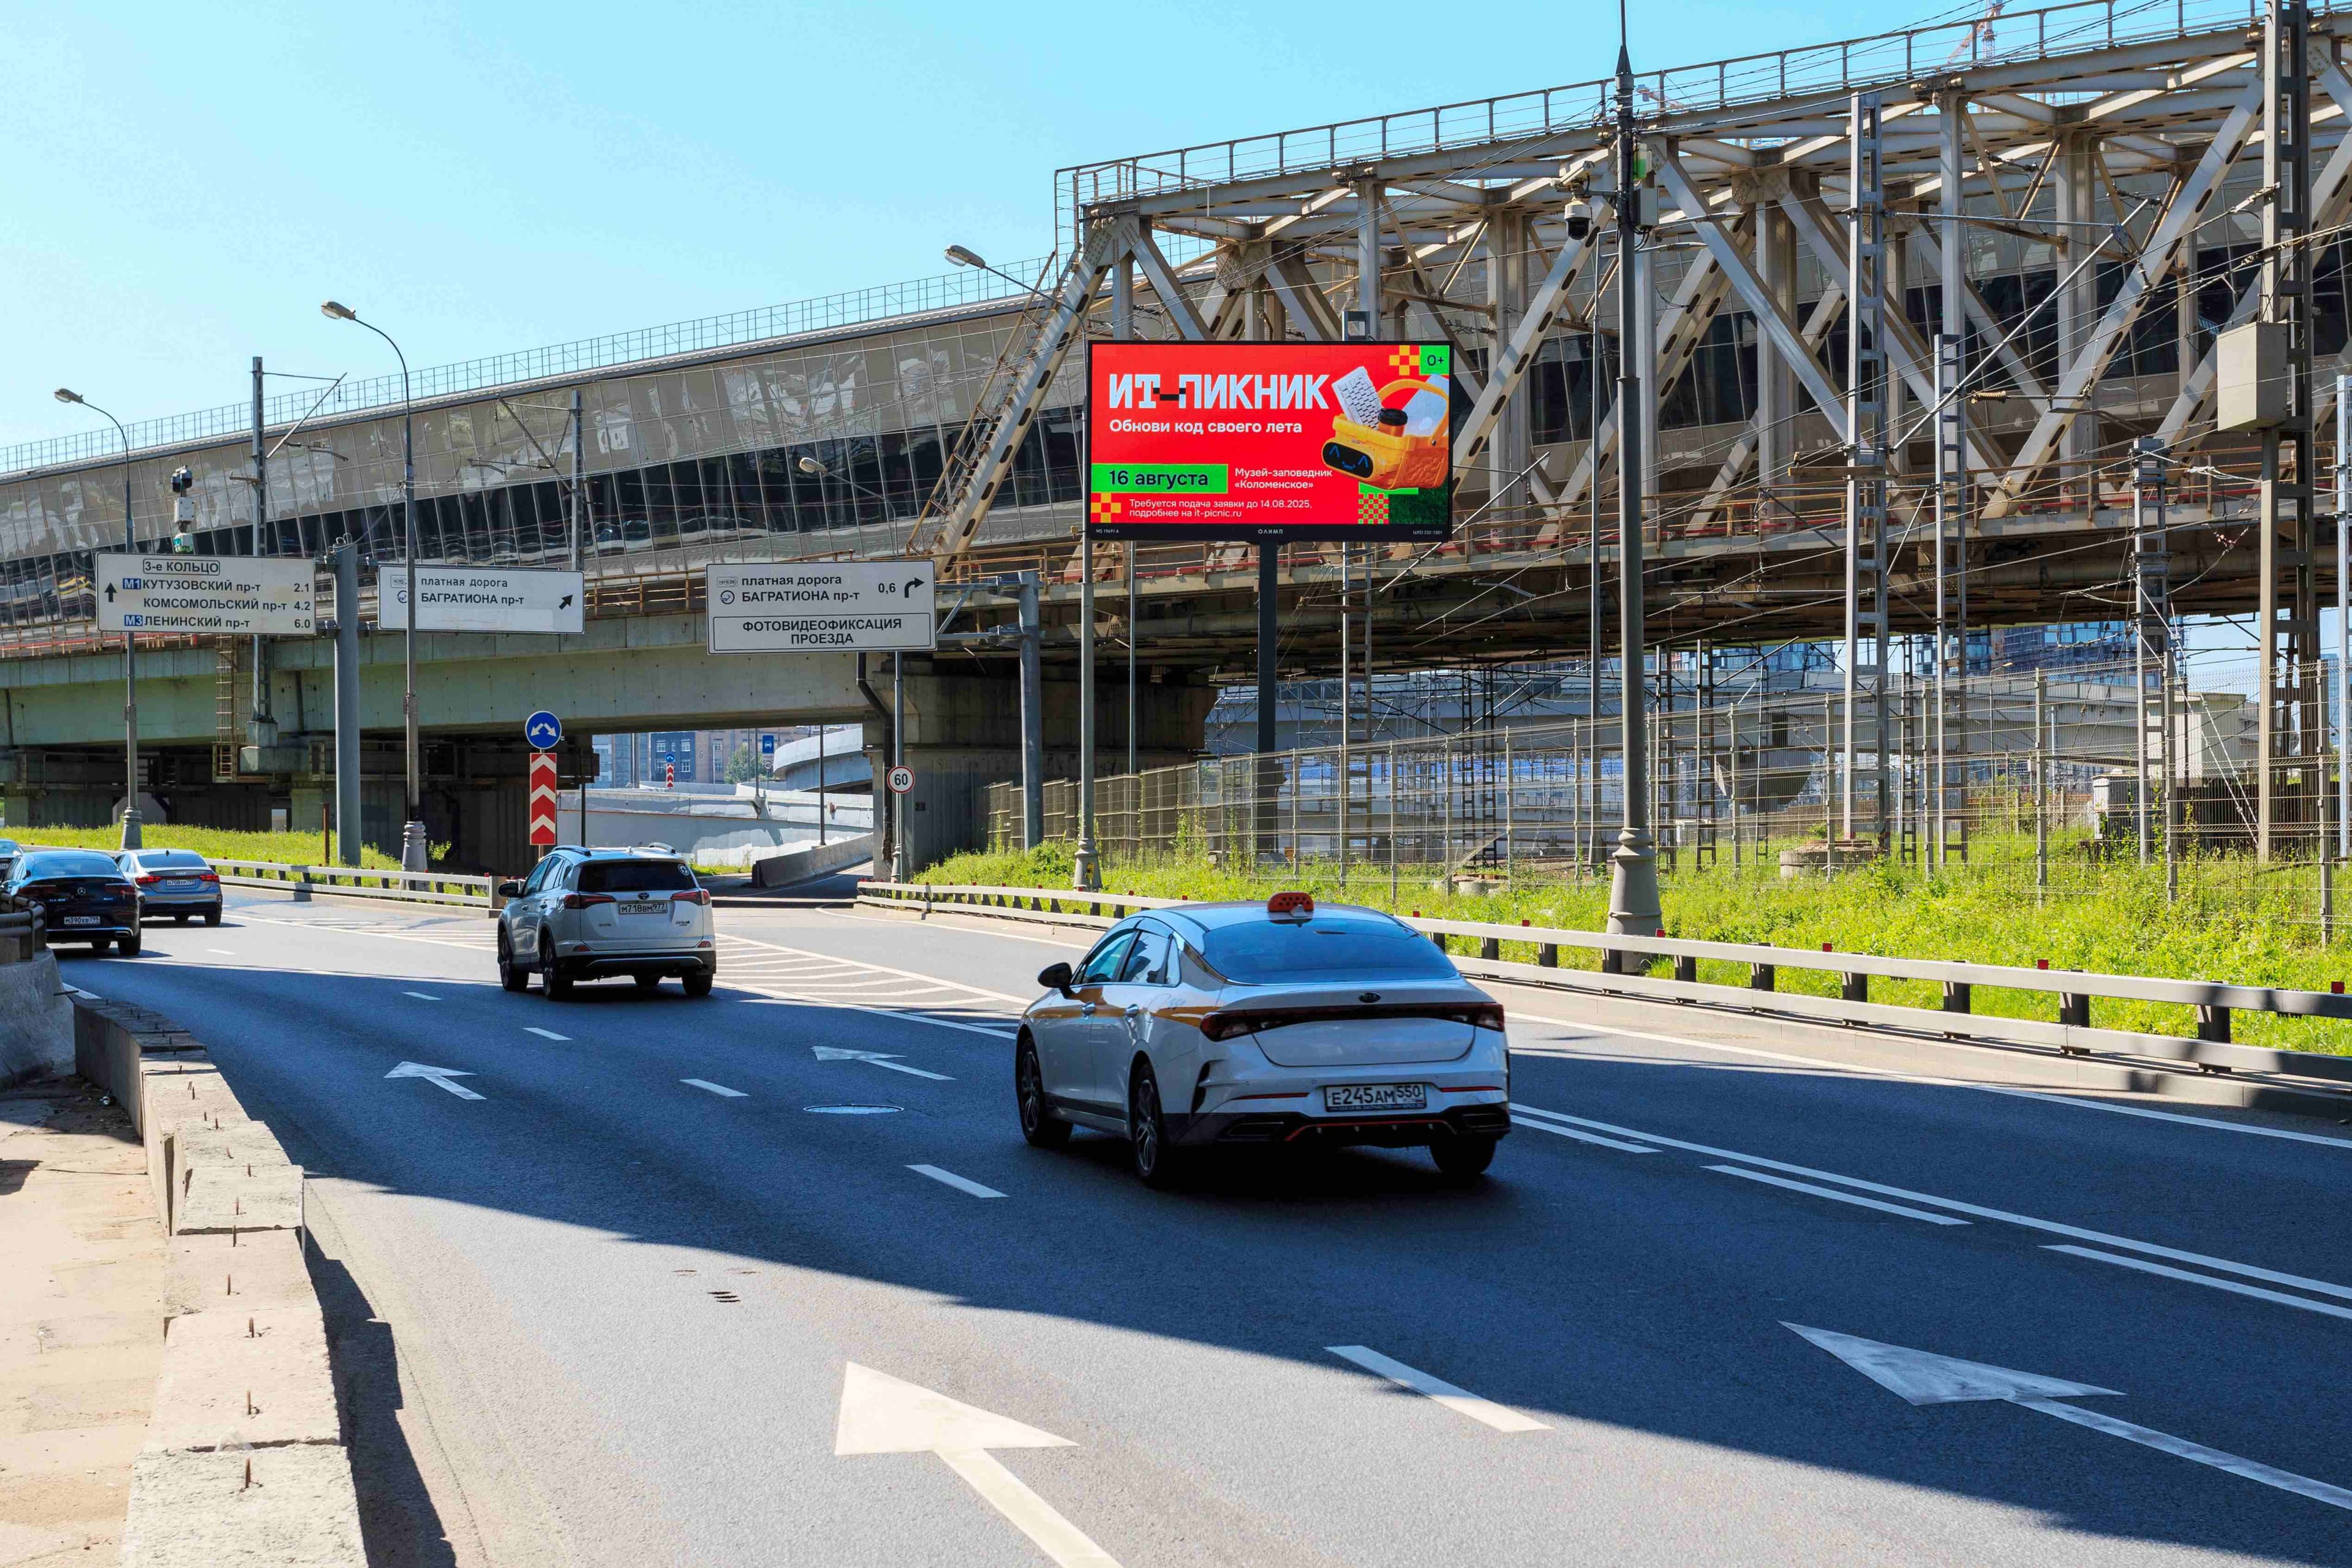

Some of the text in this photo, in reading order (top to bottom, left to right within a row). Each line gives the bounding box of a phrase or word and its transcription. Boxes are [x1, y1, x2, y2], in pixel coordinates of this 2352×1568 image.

[1427, 355, 1444, 366] 0+
[1109, 374, 1330, 409] ИТ-ПИКНИК
[1110, 419, 1302, 434] Обнови код своего лета
[1109, 470, 1208, 489] 16 августа
[1235, 468, 1332, 479] Музей-заповедник
[1129, 499, 1176, 508] Требуется
[1129, 510, 1179, 518] подробнее
[1194, 508, 1242, 518] it-picnic.ru
[145, 561, 219, 574] 3-е КОЛЬЦО
[124, 579, 309, 593] М1 КУТУЗОВСКИЙ пр-т 2.1
[470, 579, 507, 589] дорога
[797, 577, 841, 587] дорога
[742, 583, 895, 602] БАГРАТИОНА пр-т 0,6
[144, 598, 310, 612] КОМСОМОЛЬСКИЙ пр-т 4.2
[421, 593, 524, 606] БАГРАТИОНА пр-т
[125, 616, 310, 629] М3 ЛЕНИНСКИЙ пр-т 6.0
[743, 619, 901, 632] ФОТОВИДЕОФИКСАЦИЯ
[791, 633, 854, 645] ПРОЕЗДА
[894, 774, 908, 785] 60
[1332, 1085, 1421, 1105] Е245АМ 550
